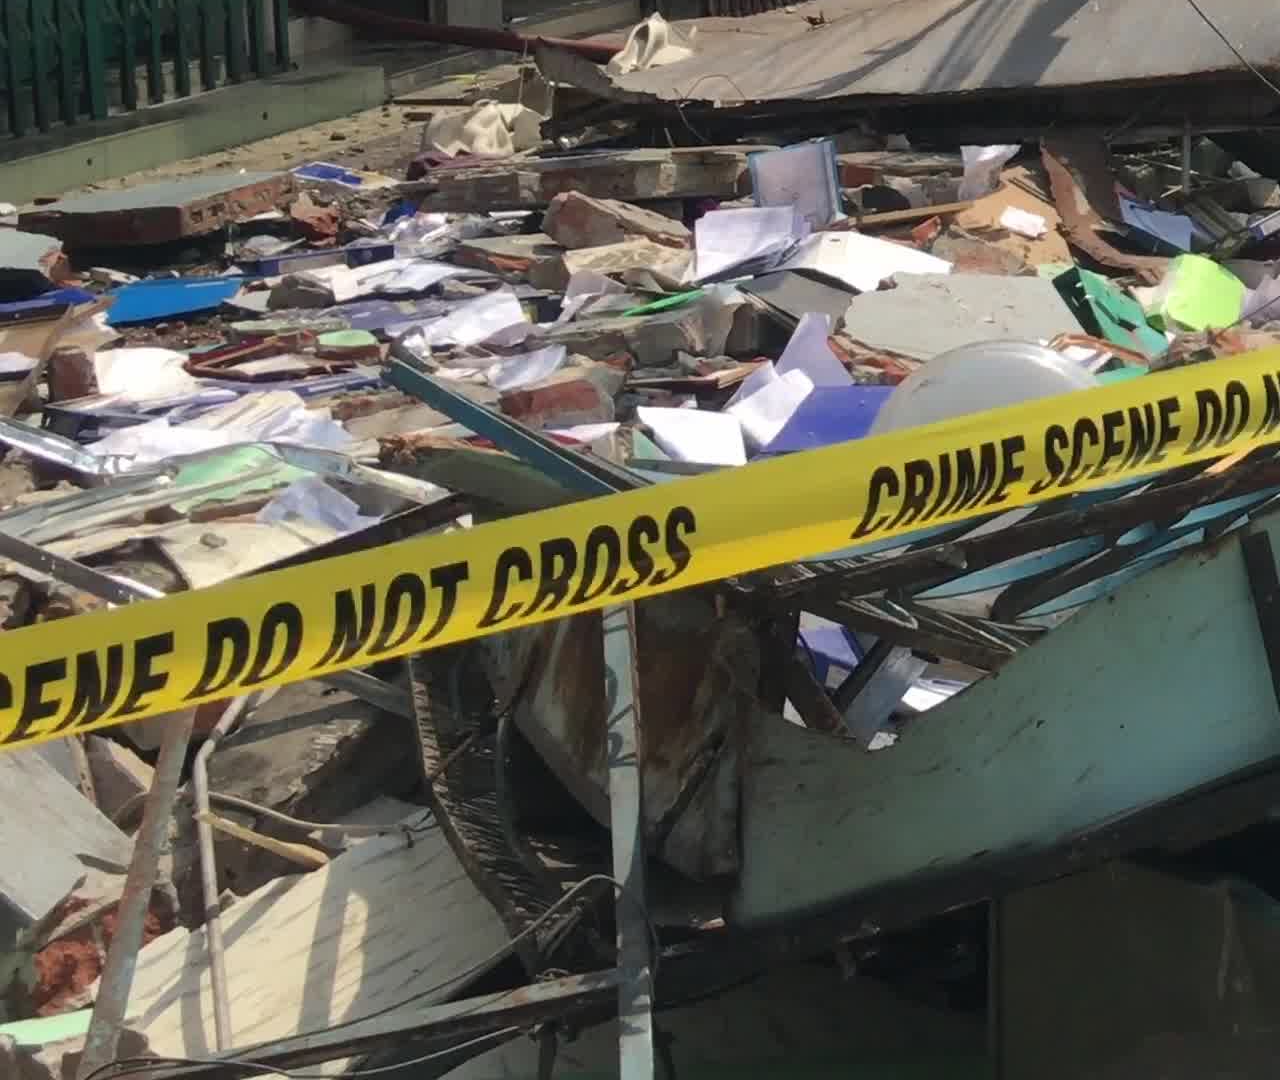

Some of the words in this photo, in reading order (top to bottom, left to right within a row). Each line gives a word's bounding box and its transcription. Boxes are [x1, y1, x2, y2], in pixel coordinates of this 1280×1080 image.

[850, 435, 1026, 540] CRIME
[1029, 396, 1181, 495] SCENE
[1184, 380, 1252, 456] DO
[186, 601, 304, 699] DO
[311, 560, 469, 669] NOT
[477, 506, 697, 629] CROSS
